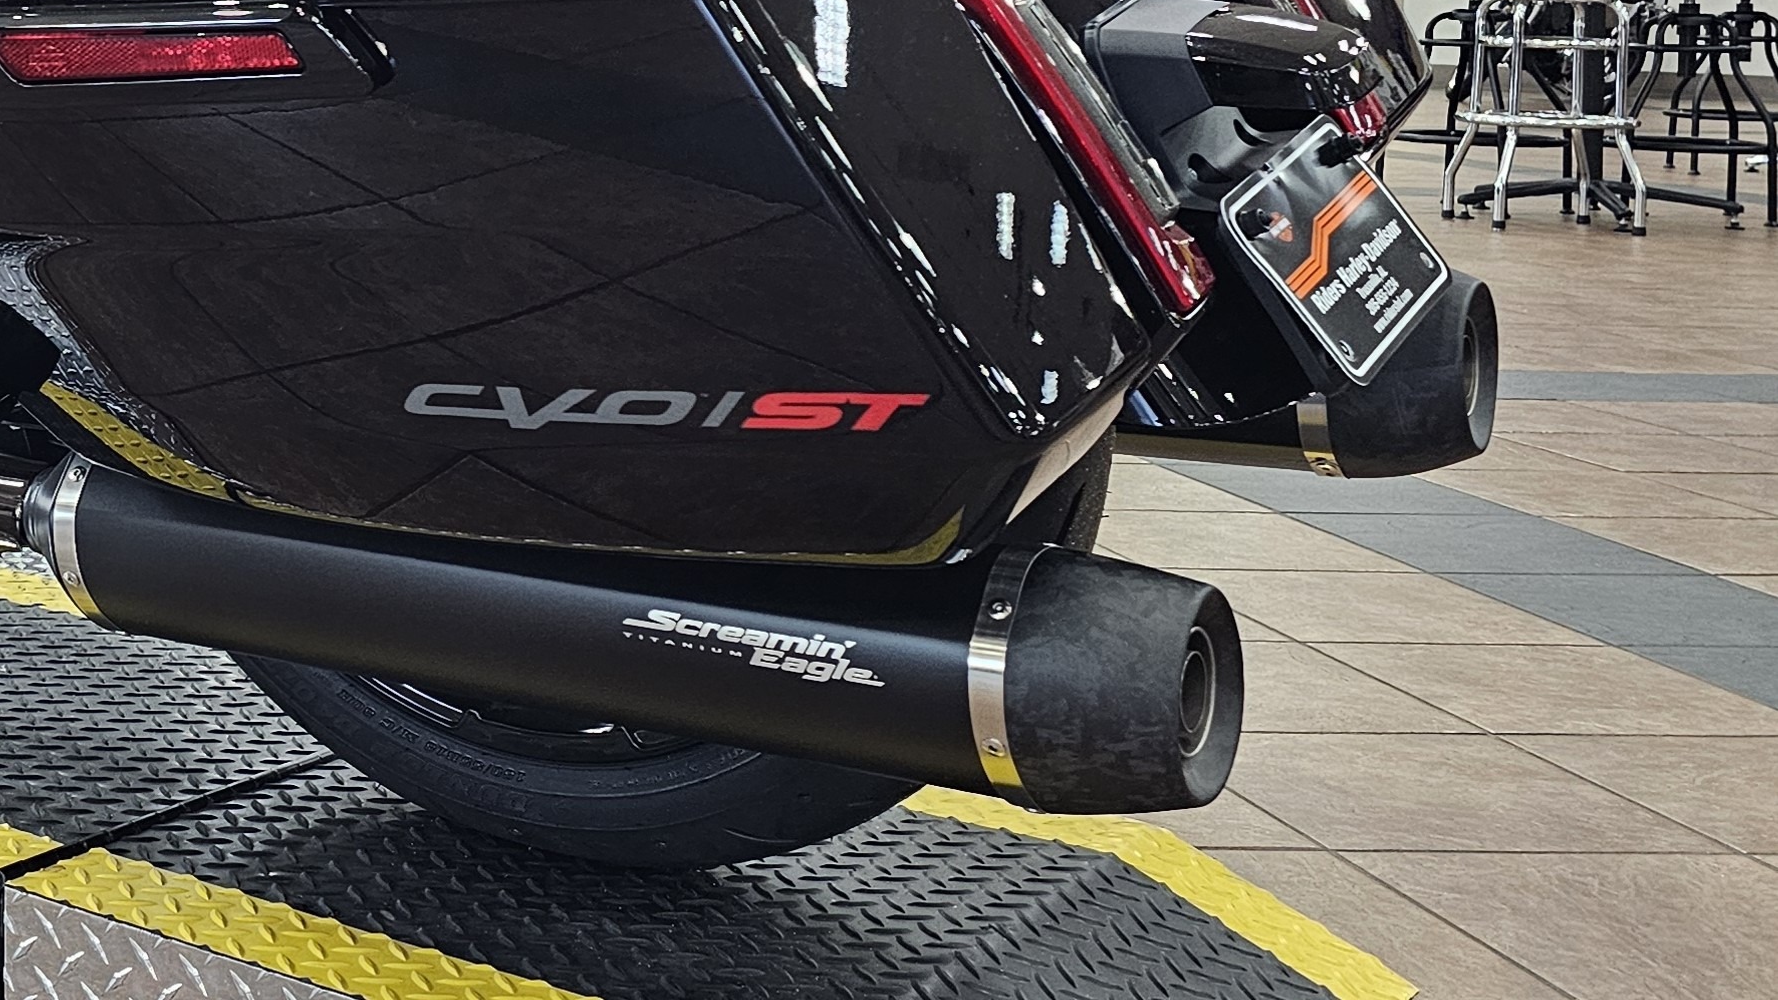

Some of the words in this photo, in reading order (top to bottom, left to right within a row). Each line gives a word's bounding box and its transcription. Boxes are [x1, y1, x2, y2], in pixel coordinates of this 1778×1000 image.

[1310, 279, 1347, 315] Riders
[403, 383, 699, 431] CVO
[739, 391, 931, 432] ST
[622, 608, 857, 660] Screamin'
[622, 631, 743, 658] TITANIUM
[748, 646, 886, 688] Eagle
